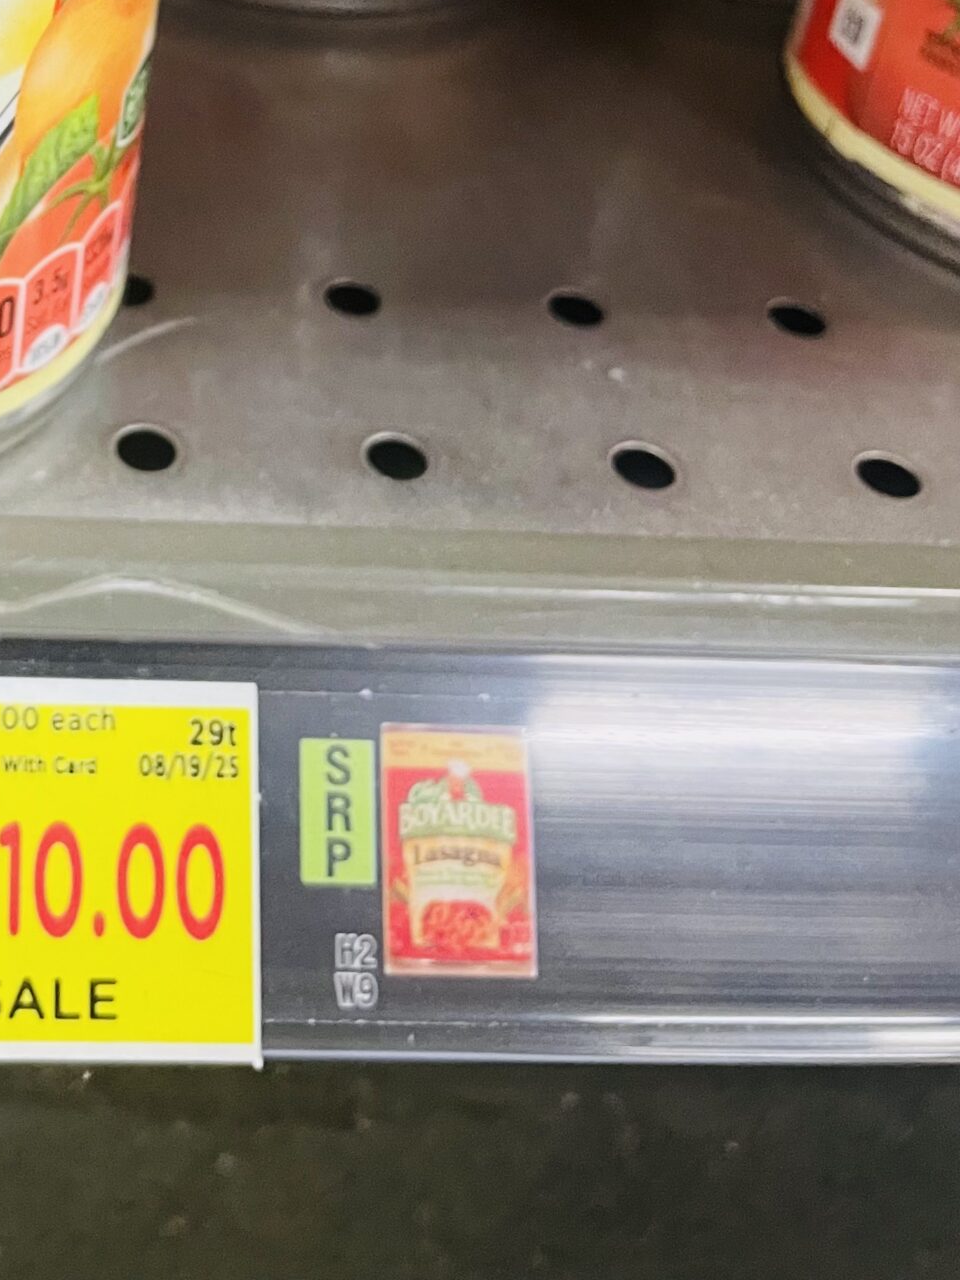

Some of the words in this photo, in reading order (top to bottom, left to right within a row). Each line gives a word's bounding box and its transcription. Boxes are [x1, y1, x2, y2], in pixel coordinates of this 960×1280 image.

[52, 706, 117, 732] each
[3, 756, 46, 773] With
[53, 757, 98, 775] Card
[139, 753, 240, 781] 08/19/25
